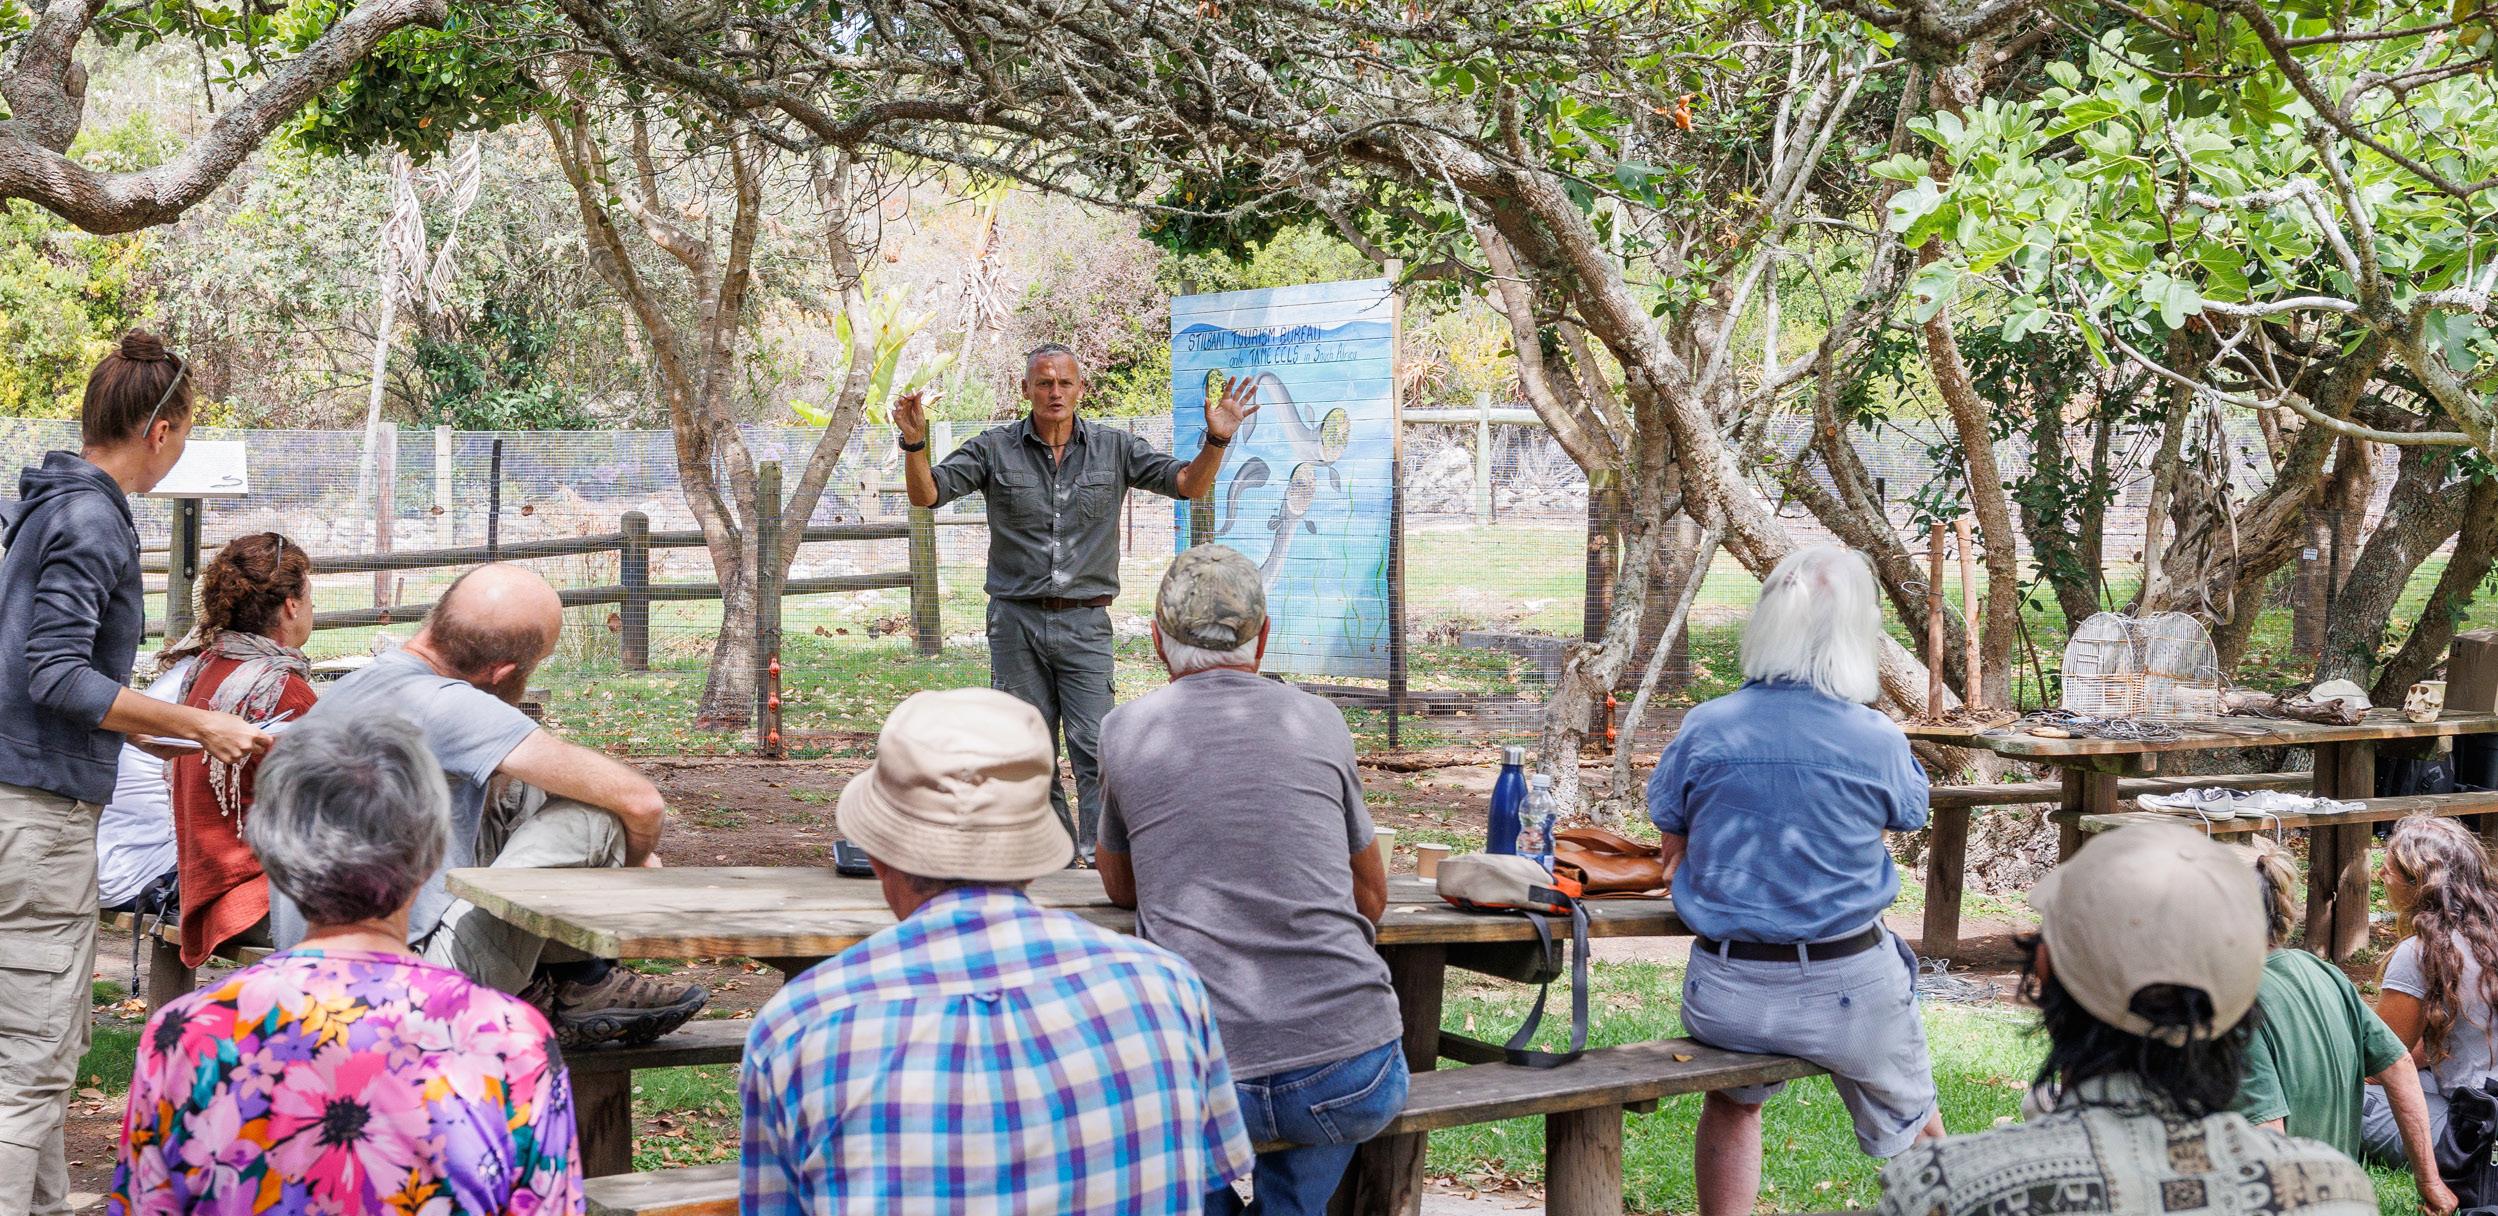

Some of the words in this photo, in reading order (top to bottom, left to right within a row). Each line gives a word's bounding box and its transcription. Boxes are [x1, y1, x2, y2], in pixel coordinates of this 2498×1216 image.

[1231, 327, 1276, 349] TOURISM
[1280, 324, 1321, 346] BUREAU
[1249, 347, 1272, 366] TAME
[1313, 343, 1334, 362] South
[1336, 342, 1358, 361] Africa
